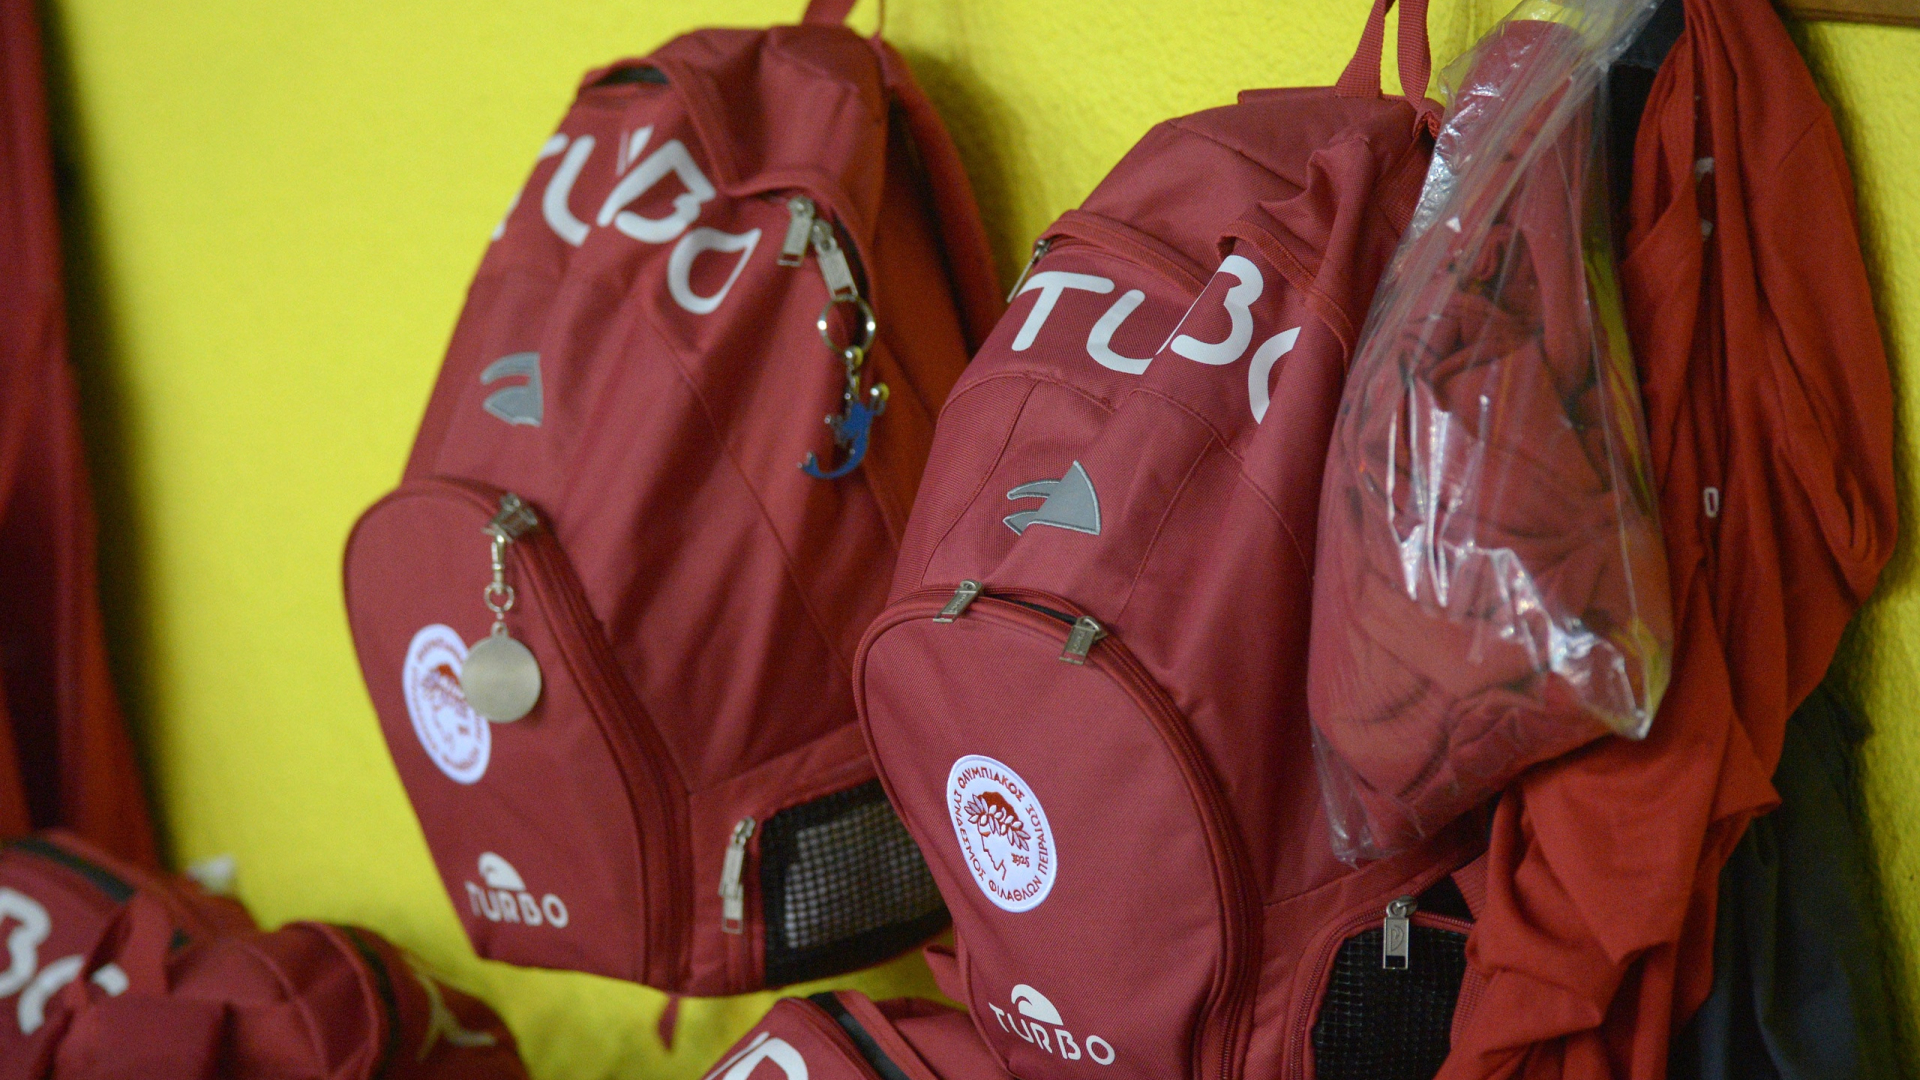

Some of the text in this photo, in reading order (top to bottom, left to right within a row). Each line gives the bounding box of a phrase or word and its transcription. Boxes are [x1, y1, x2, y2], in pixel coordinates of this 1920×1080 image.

[957, 766, 1025, 802] ΟΛΥΜΠΙΑΚΟΣ
[464, 880, 569, 929] TURBO
[988, 875, 1042, 902] ΦΙΛΑΘΛΩΝ
[988, 1001, 1116, 1066] TURBO
